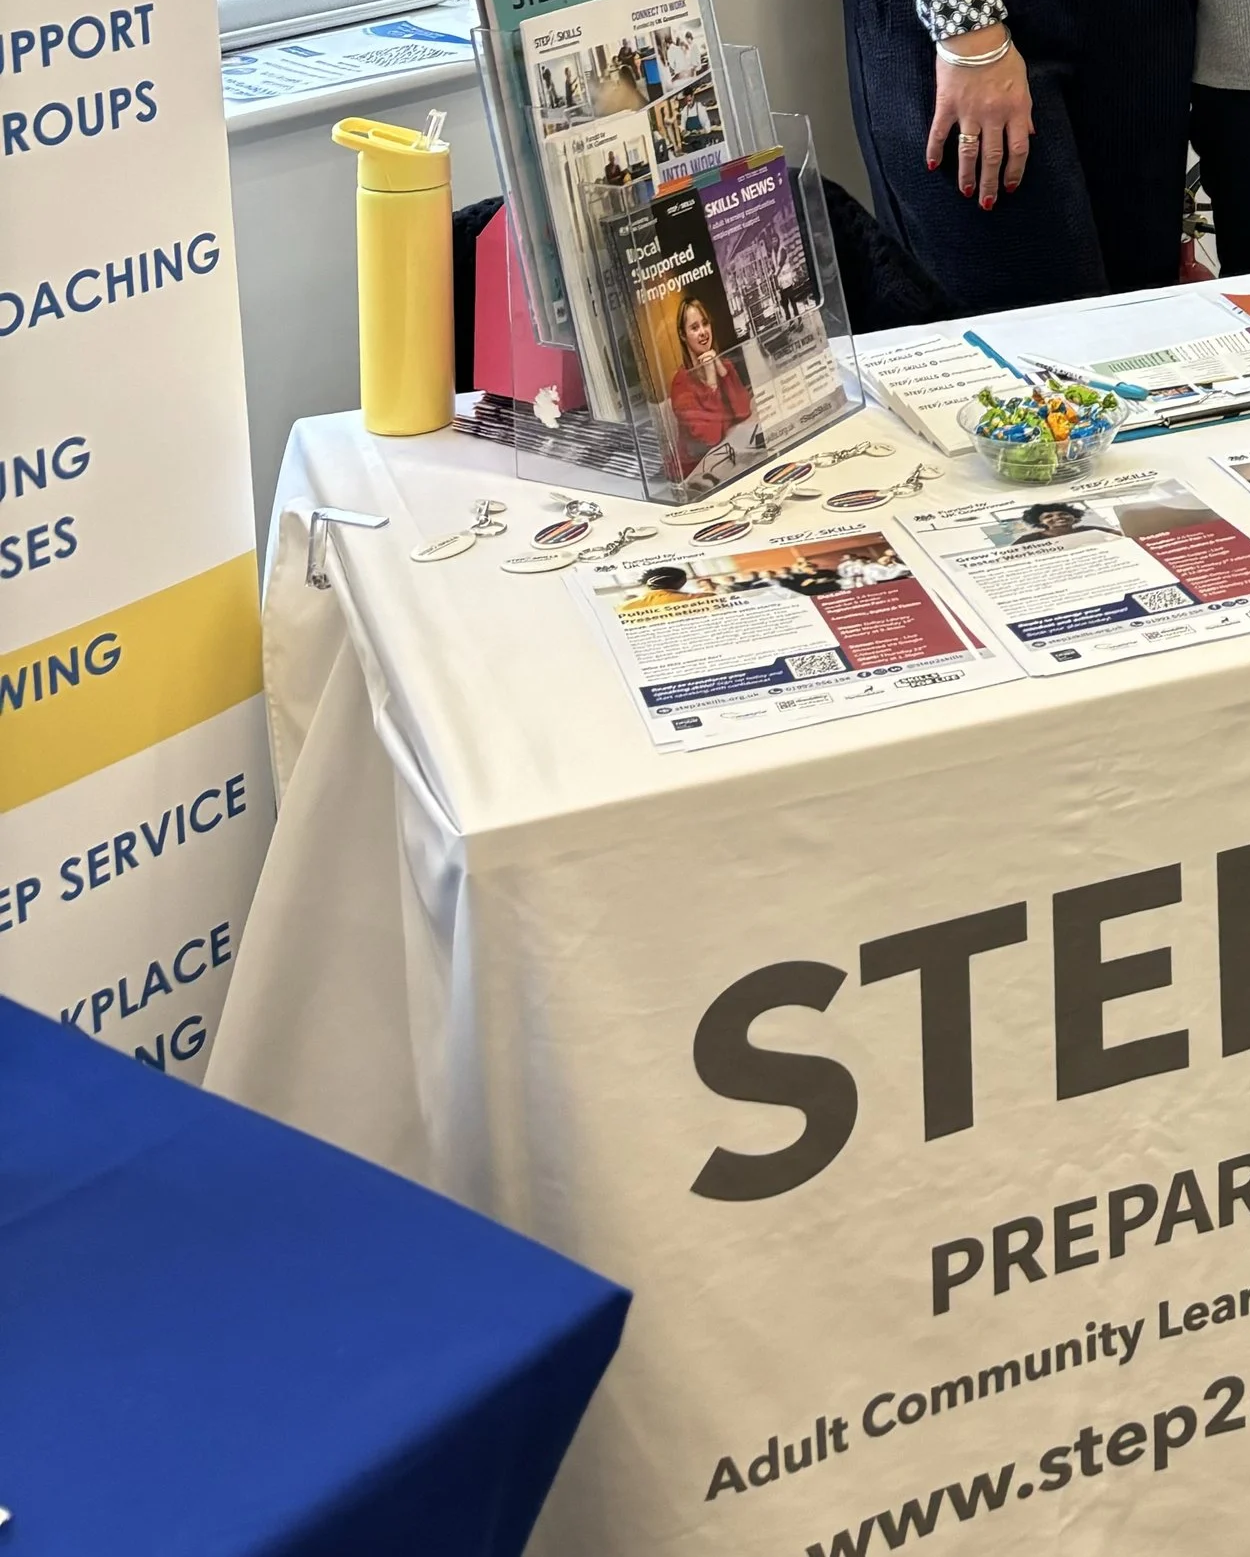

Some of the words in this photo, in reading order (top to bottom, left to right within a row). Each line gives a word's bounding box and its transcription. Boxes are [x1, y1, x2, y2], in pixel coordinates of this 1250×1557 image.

[0, 2, 153, 74] PPORT
[662, 165, 688, 183] INTO
[691, 154, 721, 175] WORK
[704, 193, 739, 218] SKILLS
[741, 176, 776, 203] NEWS
[631, 243, 695, 285] Supported
[1001, 545, 1065, 562] Workshop
[617, 607, 661, 619] Public
[664, 597, 725, 612] Speaking
[621, 606, 710, 625] Presentation
[712, 599, 750, 610] Skills
[59, 772, 247, 902] SERVICE
[703, 1415, 850, 1503] Adult
[861, 1317, 1146, 1439] Community
